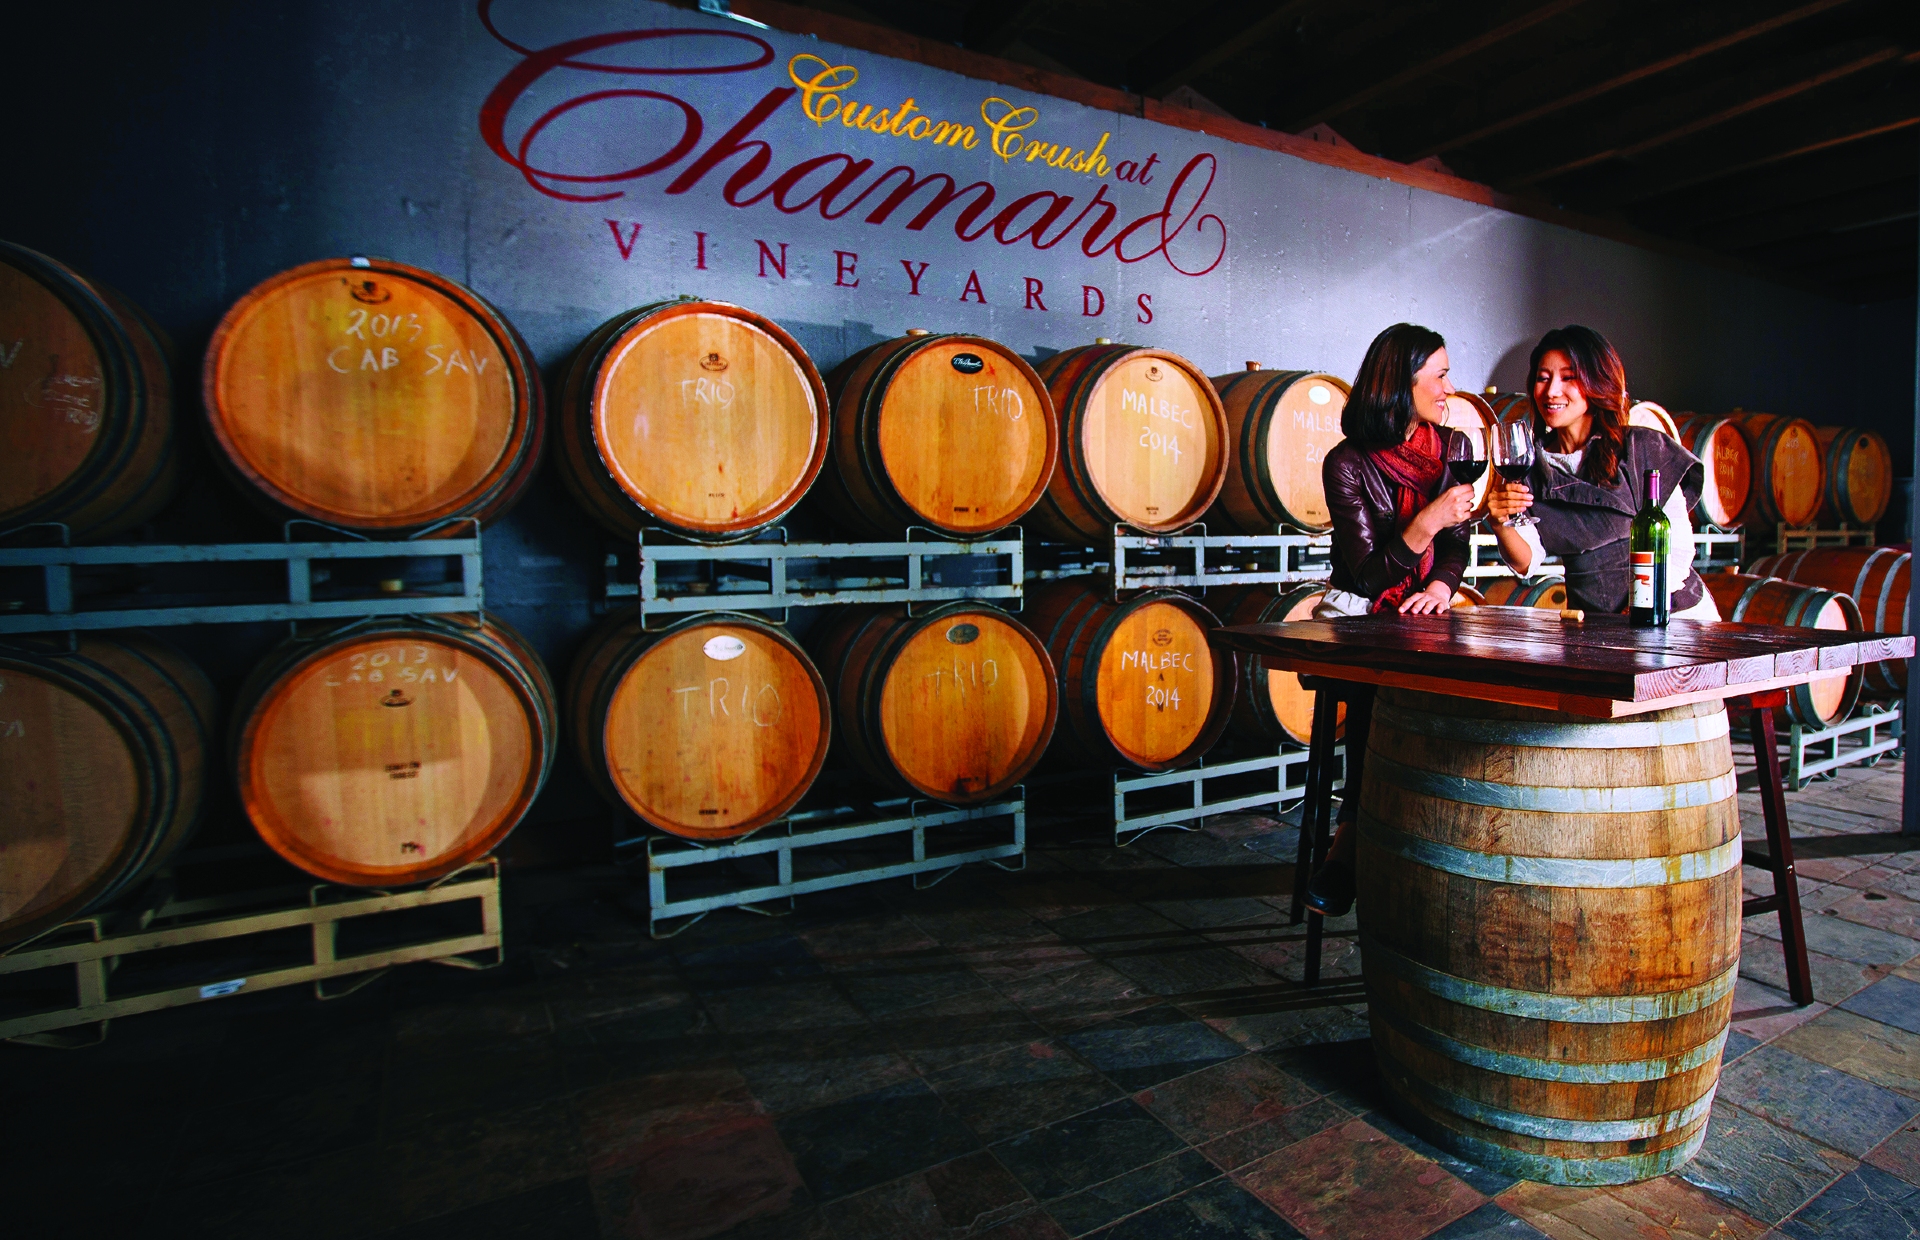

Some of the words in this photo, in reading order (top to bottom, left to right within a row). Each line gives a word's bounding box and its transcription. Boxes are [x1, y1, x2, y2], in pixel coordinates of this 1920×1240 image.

[478, 0, 1227, 276] Chamard
[788, 54, 982, 150] Custom
[981, 96, 1112, 177] Crush
[1114, 152, 1155, 185] at
[603, 219, 1156, 325] VINEYARDS
[327, 346, 400, 374] CAB
[425, 346, 488, 376] SAV
[677, 377, 737, 410] TRIO
[970, 385, 1023, 421] TRIO
[1121, 387, 1193, 429] MALBEC
[1139, 426, 1182, 465] 2014
[350, 647, 430, 670] 2013
[399, 667, 458, 683] SAV
[1121, 650, 1194, 674] MALBEC
[925, 657, 999, 707] TRIO
[1146, 685, 1182, 711] 2014
[673, 677, 782, 728] TRIO
